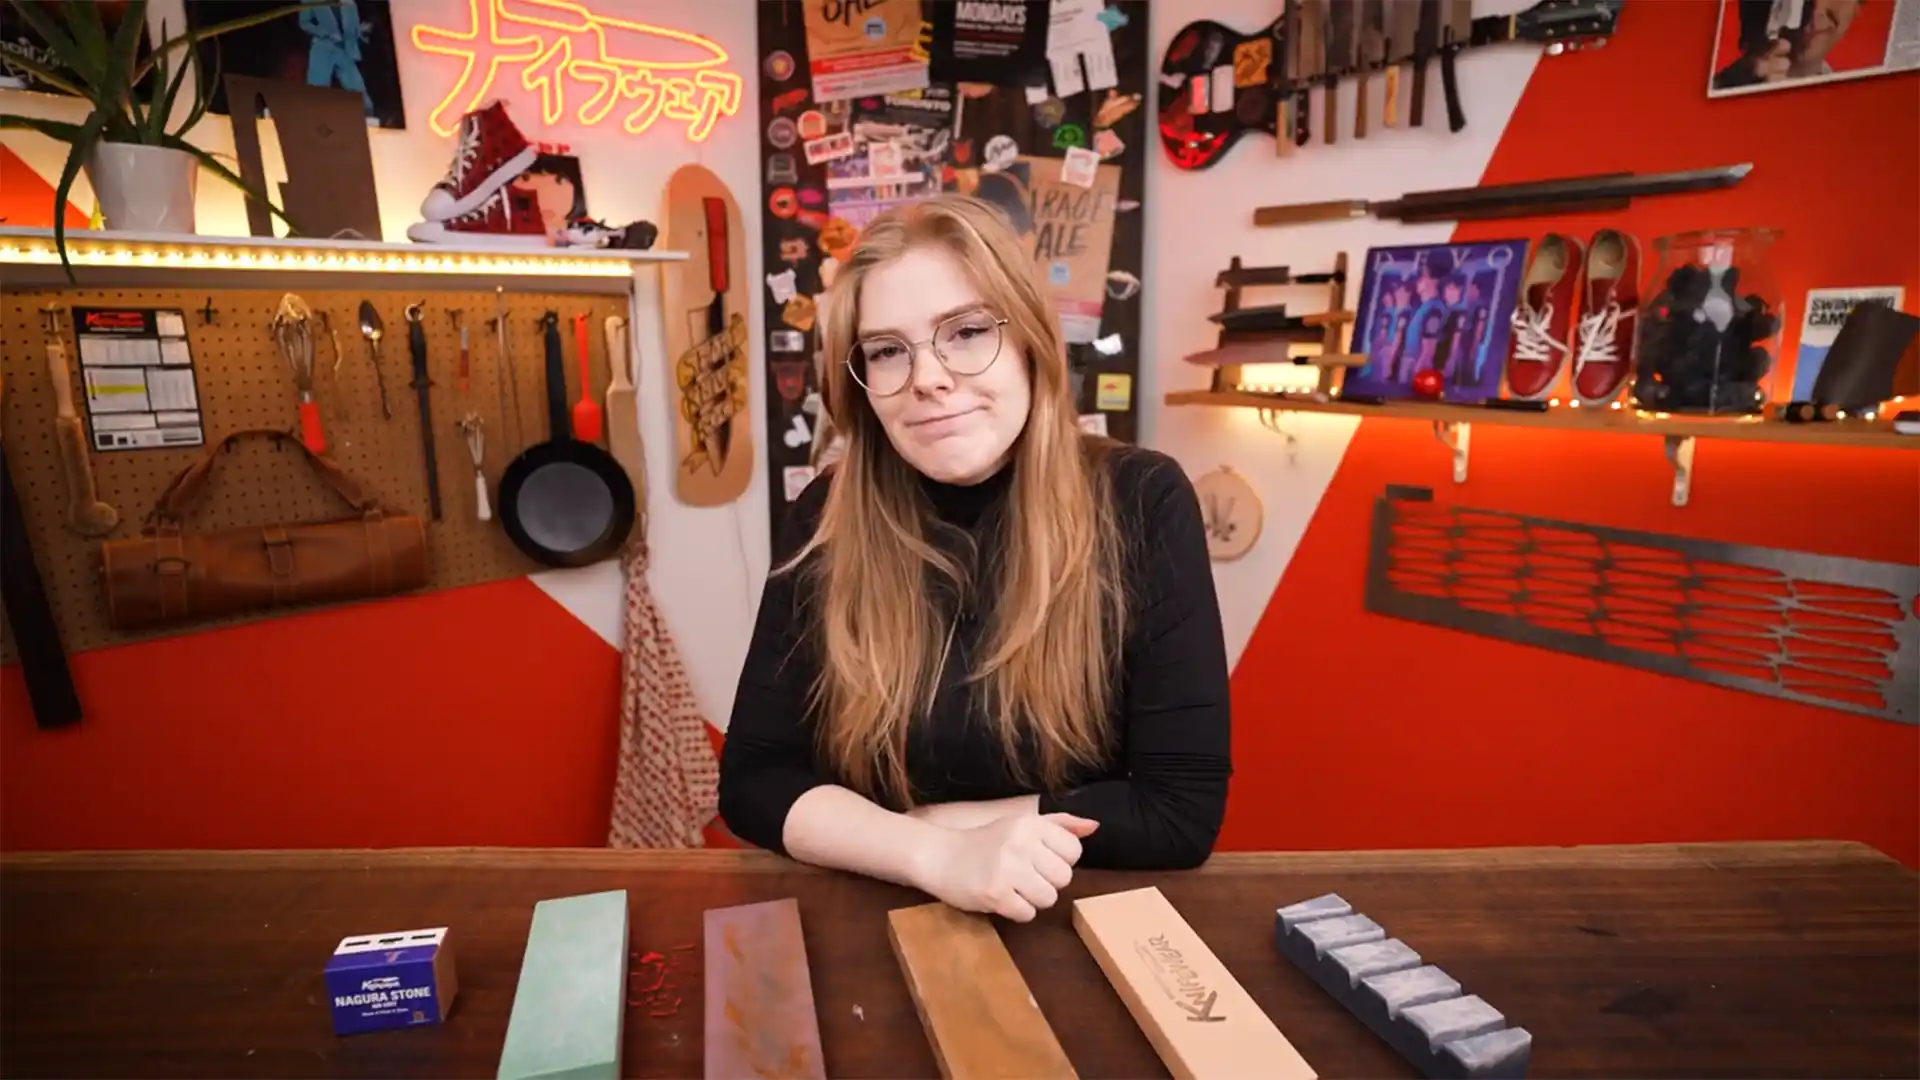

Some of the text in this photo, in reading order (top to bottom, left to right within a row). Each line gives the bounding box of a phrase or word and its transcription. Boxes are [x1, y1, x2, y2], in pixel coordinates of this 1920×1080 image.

[955, 2, 1027, 25] MONDAYS
[1033, 222, 1088, 263] ALE
[334, 991, 389, 1008] NAGURA
[390, 986, 432, 1001] STONE
